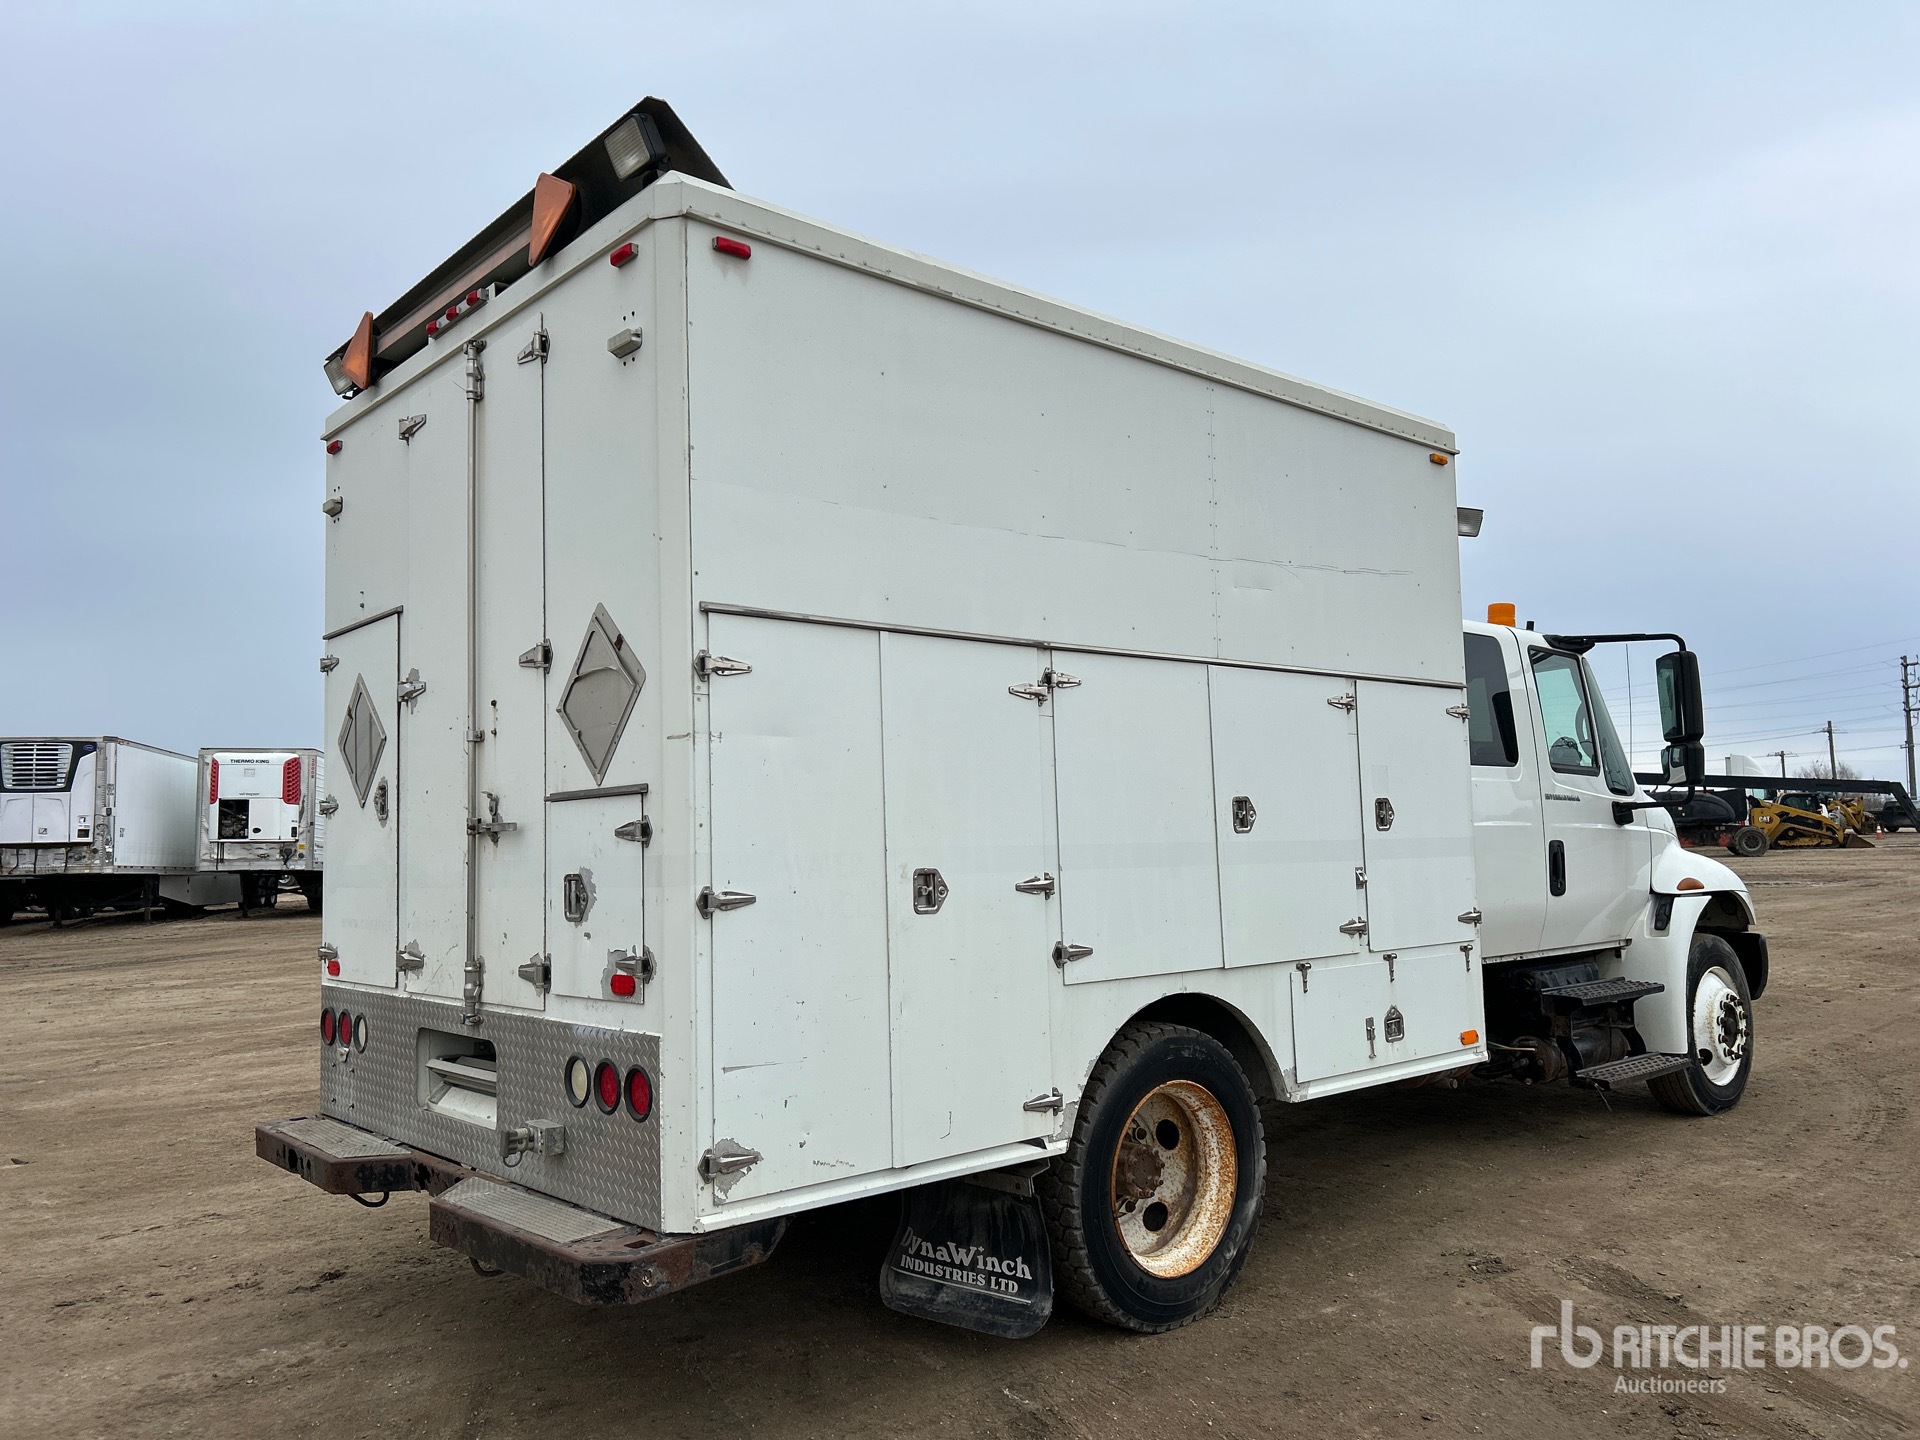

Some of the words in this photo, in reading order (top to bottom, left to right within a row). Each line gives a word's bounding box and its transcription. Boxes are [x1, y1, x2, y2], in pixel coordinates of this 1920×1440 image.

[900, 1226, 1033, 1280] DynaWinch
[900, 1254, 986, 1286] INDUSTRIES
[989, 1276, 1019, 1294] LTD
